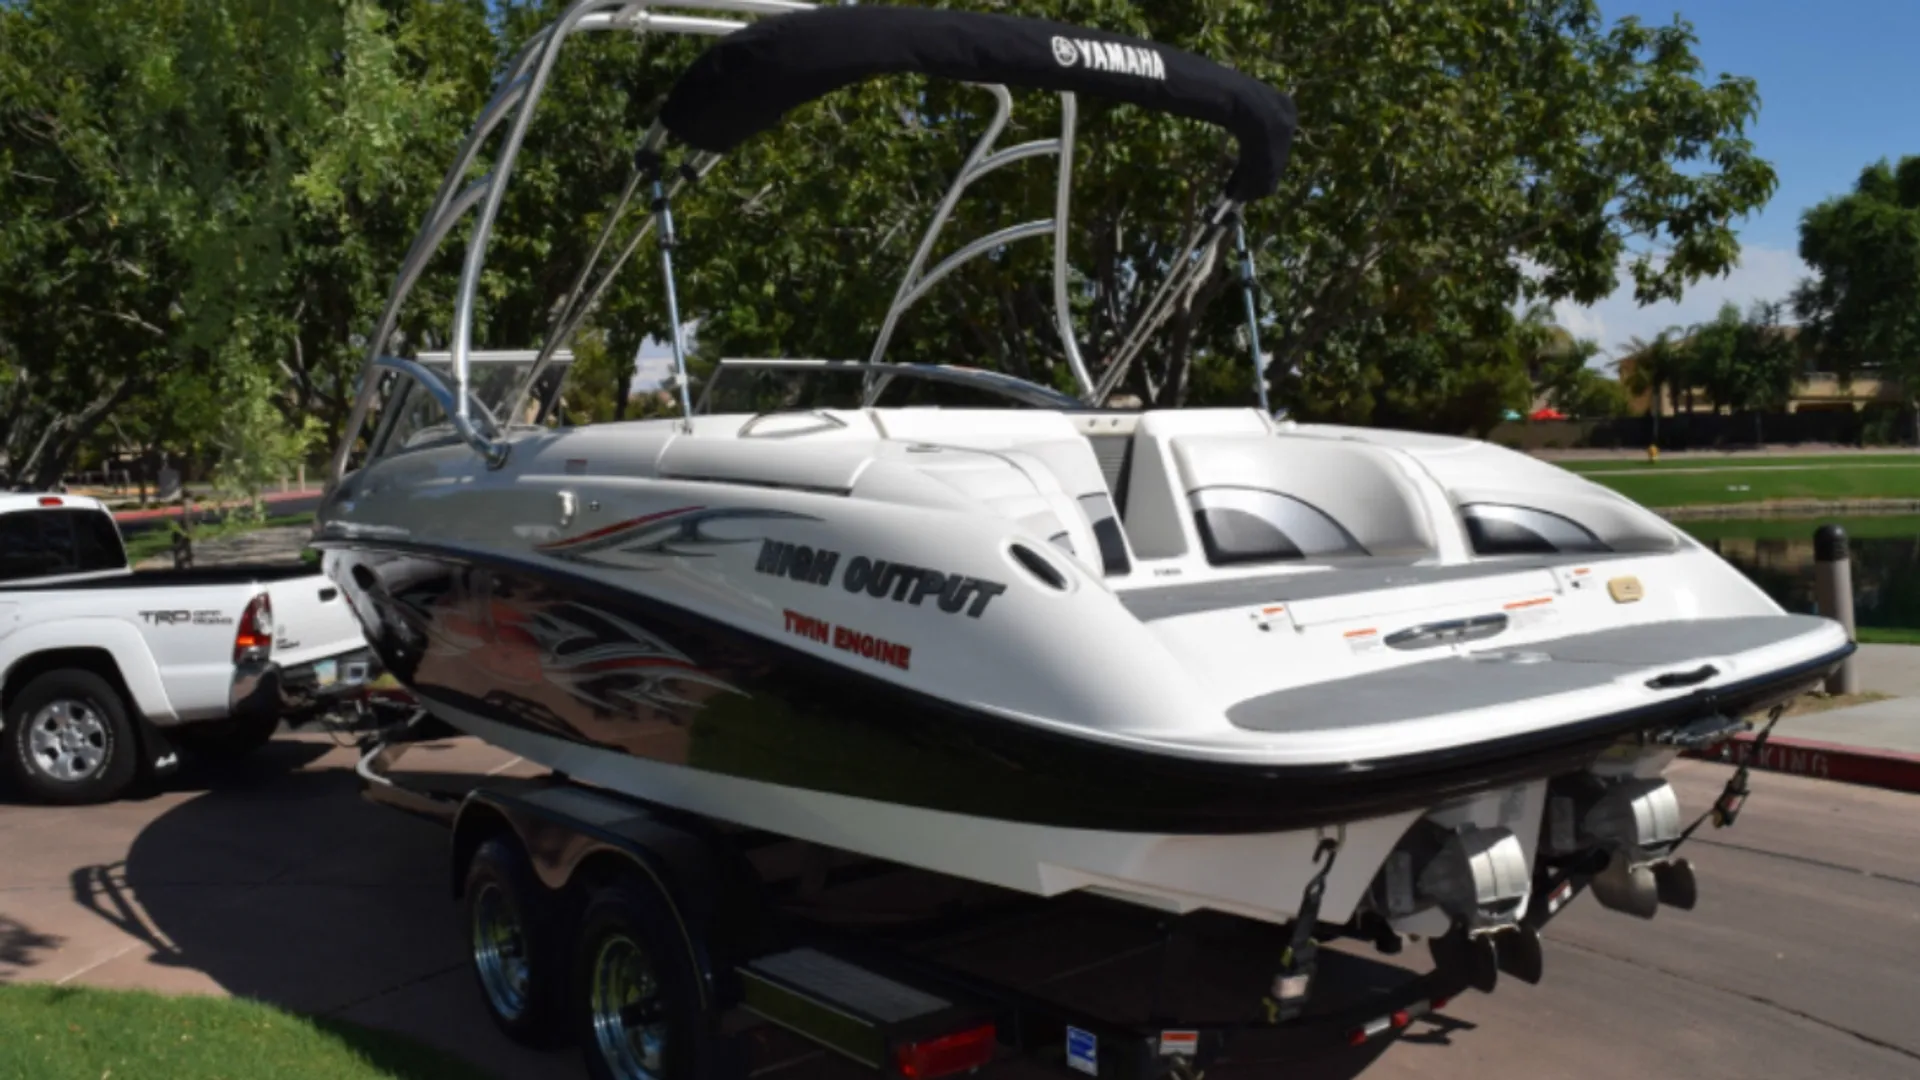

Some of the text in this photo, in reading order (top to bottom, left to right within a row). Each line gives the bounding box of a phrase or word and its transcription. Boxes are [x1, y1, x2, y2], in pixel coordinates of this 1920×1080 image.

[1075, 38, 1165, 80] YAMAHA
[755, 537, 1006, 618] HIGH OUTPUT
[139, 610, 191, 625] TRD
[783, 609, 912, 670] TWIN ENGINE
